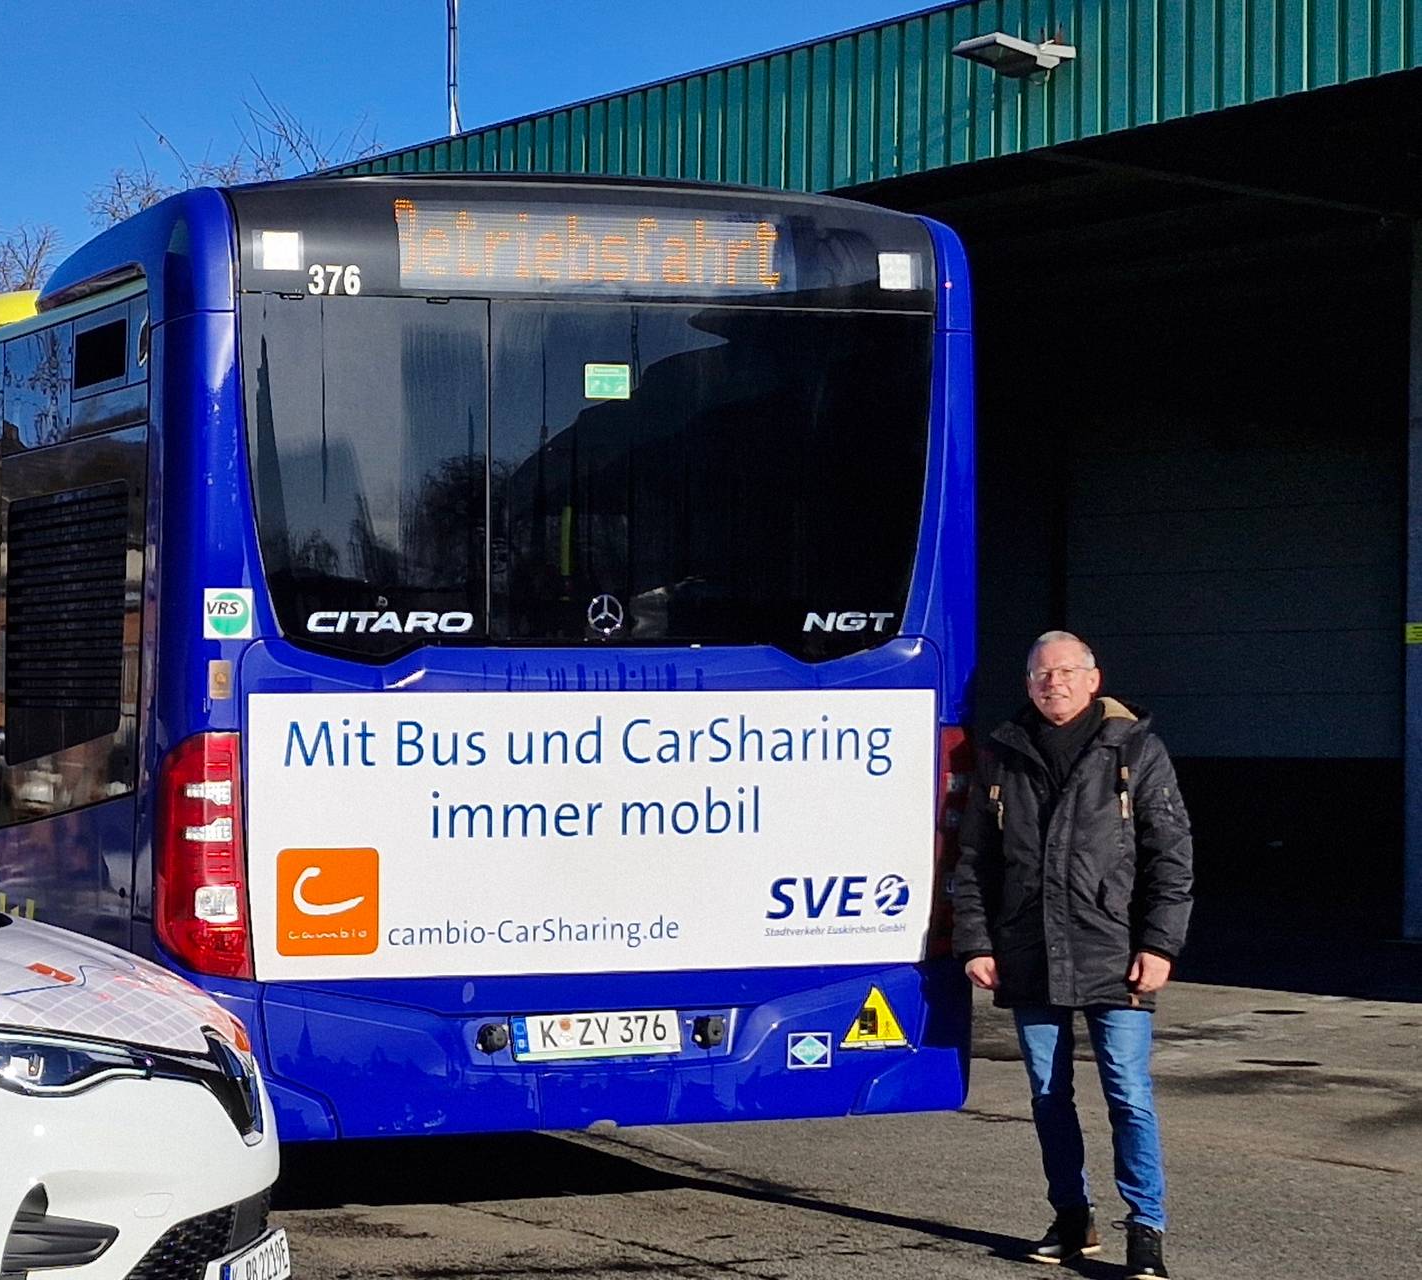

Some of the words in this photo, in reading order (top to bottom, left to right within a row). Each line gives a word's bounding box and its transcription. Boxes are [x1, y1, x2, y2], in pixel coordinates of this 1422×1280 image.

[307, 263, 362, 296] 376
[206, 601, 239, 615] VRS
[306, 611, 474, 633] CITARO
[802, 611, 894, 632] NGT
[284, 720, 376, 768] Mit
[397, 720, 487, 767] Bus
[508, 715, 602, 766] und
[622, 715, 892, 777] CarSharing
[431, 791, 604, 839] immer
[621, 786, 759, 837] mobil
[765, 876, 868, 920] SVE
[287, 927, 368, 941] cambio
[388, 915, 679, 949] cambio-CarSharing.de
[764, 925, 826, 937] Stadtverkehr
[826, 924, 876, 935] Euskirchen
[878, 922, 906, 934] GmbH
[539, 1020, 558, 1048] K
[576, 1016, 610, 1046] ZY
[618, 1014, 667, 1043] 376
